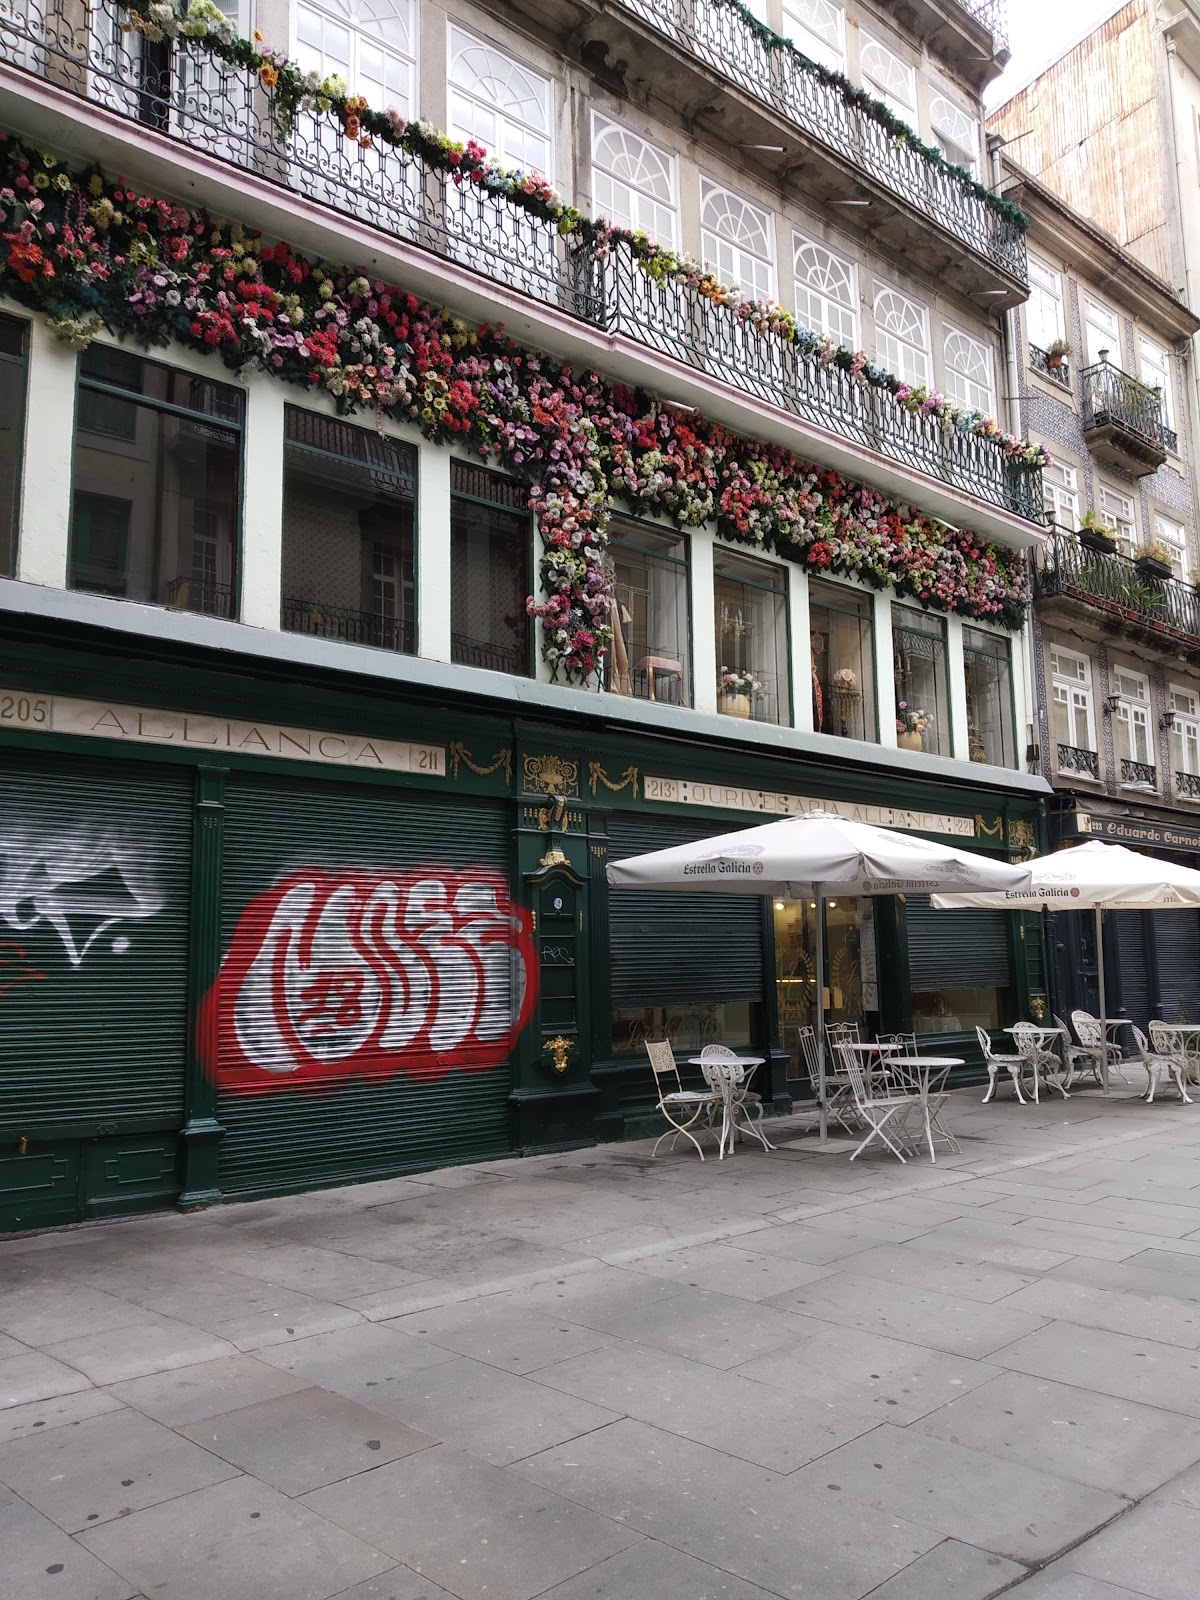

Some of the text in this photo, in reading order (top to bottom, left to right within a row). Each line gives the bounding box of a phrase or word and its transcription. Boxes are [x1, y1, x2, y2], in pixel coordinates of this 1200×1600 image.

[0, 696, 47, 723] 205
[418, 750, 438, 770] 211
[1107, 822, 1161, 841] Eduardo
[683, 861, 751, 875] Estrella Galicia
[1038, 887, 1069, 898] Galicia
